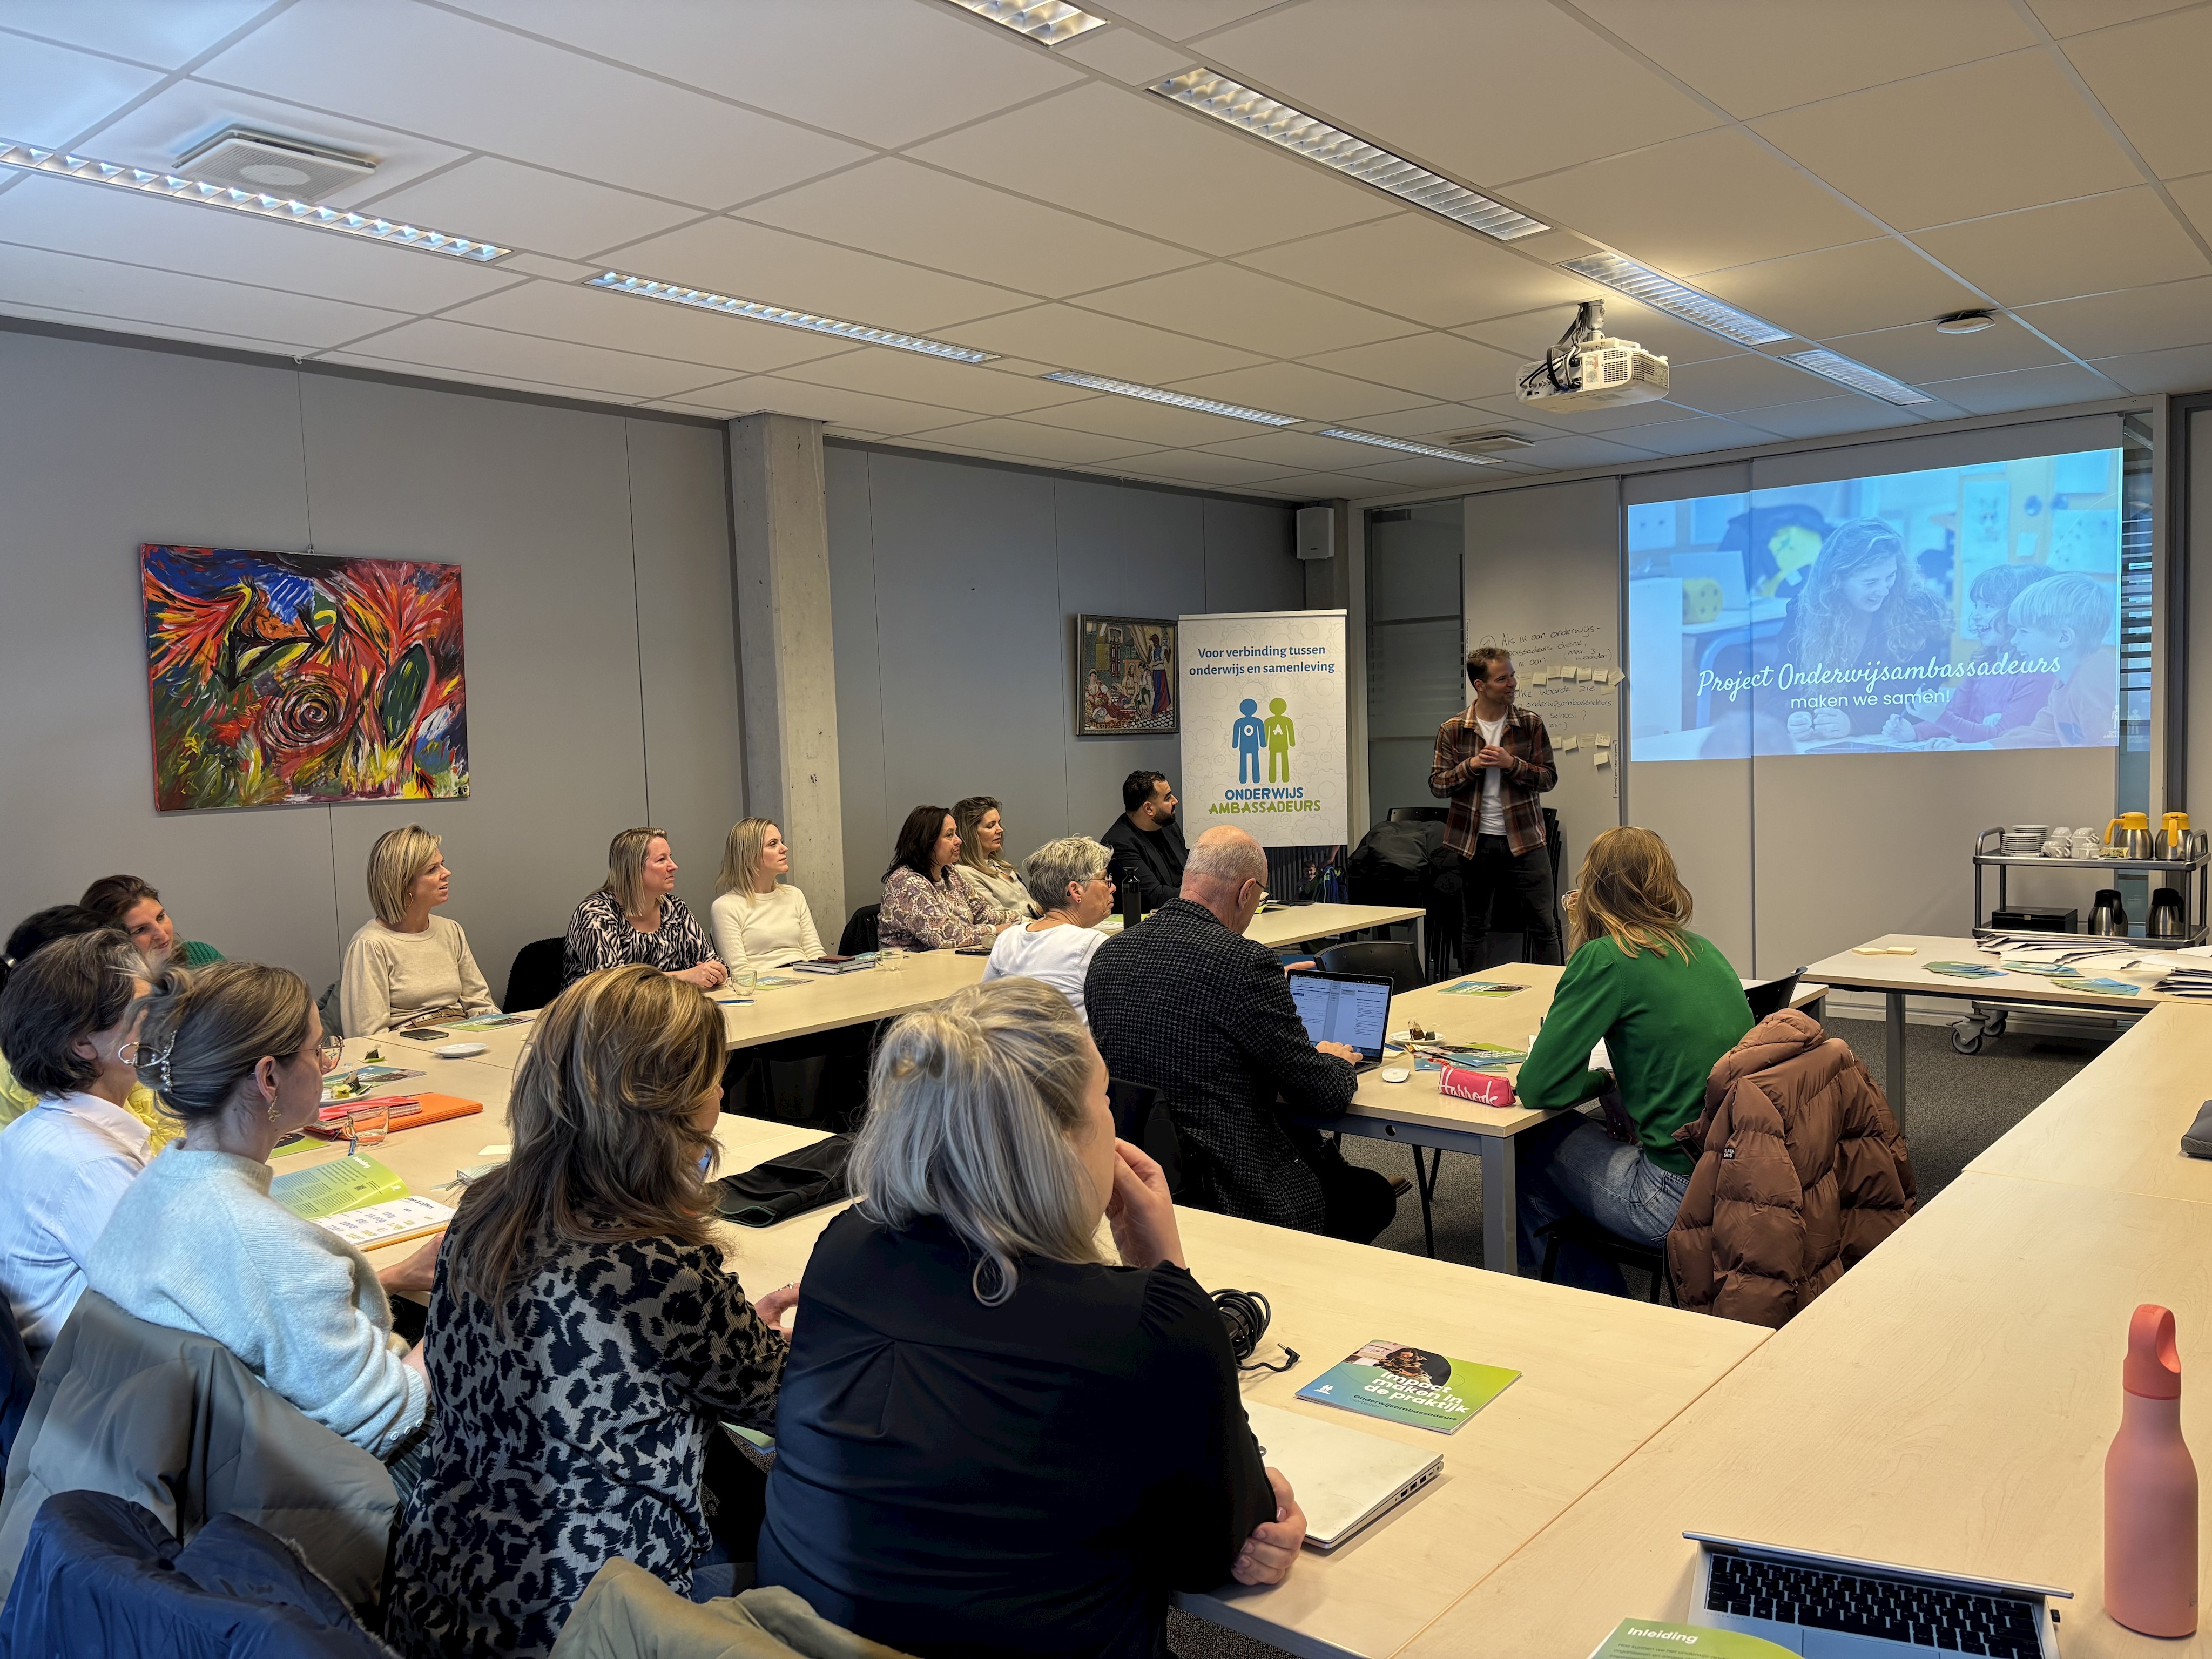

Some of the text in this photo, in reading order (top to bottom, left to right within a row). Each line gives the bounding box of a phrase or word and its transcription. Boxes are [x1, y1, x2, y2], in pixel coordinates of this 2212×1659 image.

[1501, 633, 1515, 647] Als
[1531, 633, 1546, 641] aan
[1198, 645, 1326, 658] Voor verbinding tussen
[1509, 645, 1553, 656] assadeurs
[1530, 657, 1546, 665] aan
[1189, 661, 1335, 676] onderwijs en samenleving
[1697, 652, 2061, 702] Project Onderwijsambassadeurs
[1514, 689, 1532, 698] lke
[1790, 690, 1950, 709] maken we samen!
[1244, 724, 1283, 736] O A
[1225, 787, 1304, 801] ONDERWIJS
[1208, 800, 1321, 814] AMBASSADEURS
[1380, 1371, 1452, 1393] Impact
[1372, 1378, 1463, 1404] maken in
[1364, 1384, 1470, 1413] de praktijk
[1354, 1394, 1457, 1421] Onderwijsambassadeurs
[1627, 1627, 1699, 1644] Inleiding
